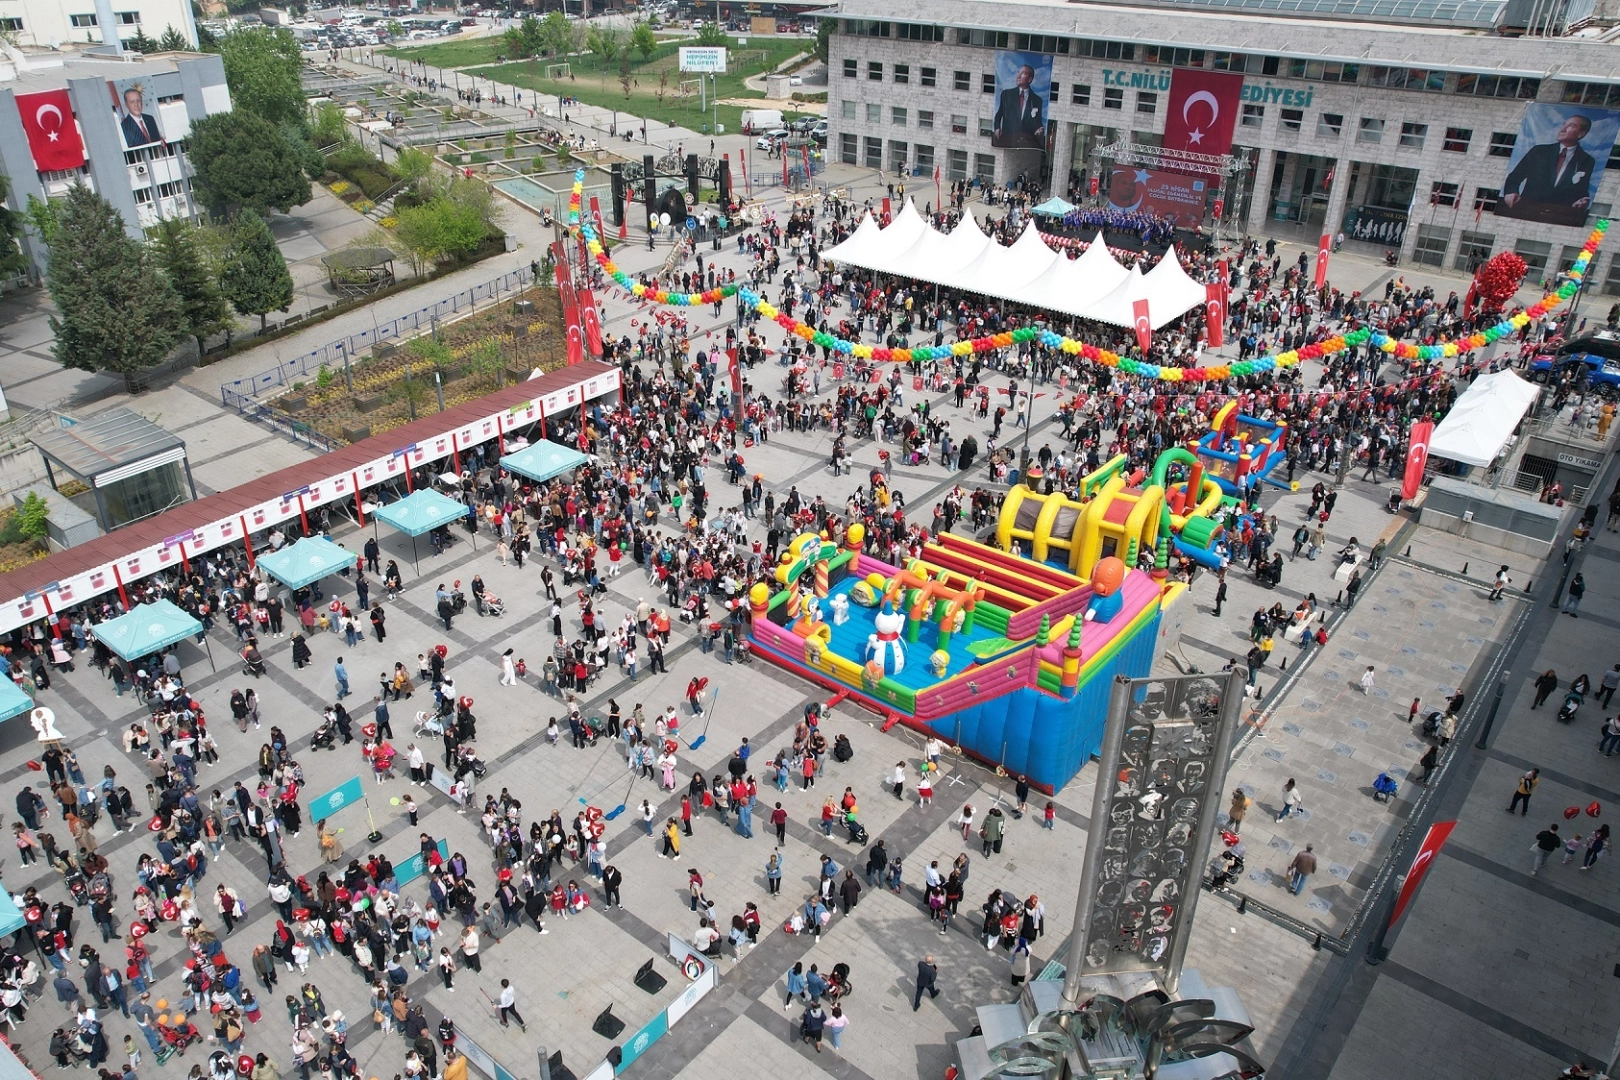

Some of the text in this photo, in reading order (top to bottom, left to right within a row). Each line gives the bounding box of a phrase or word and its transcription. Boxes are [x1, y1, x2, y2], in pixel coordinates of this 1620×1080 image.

[1241, 81, 1314, 108] EDİYESİ
[1559, 454, 1601, 468] OTO YIKAMA
